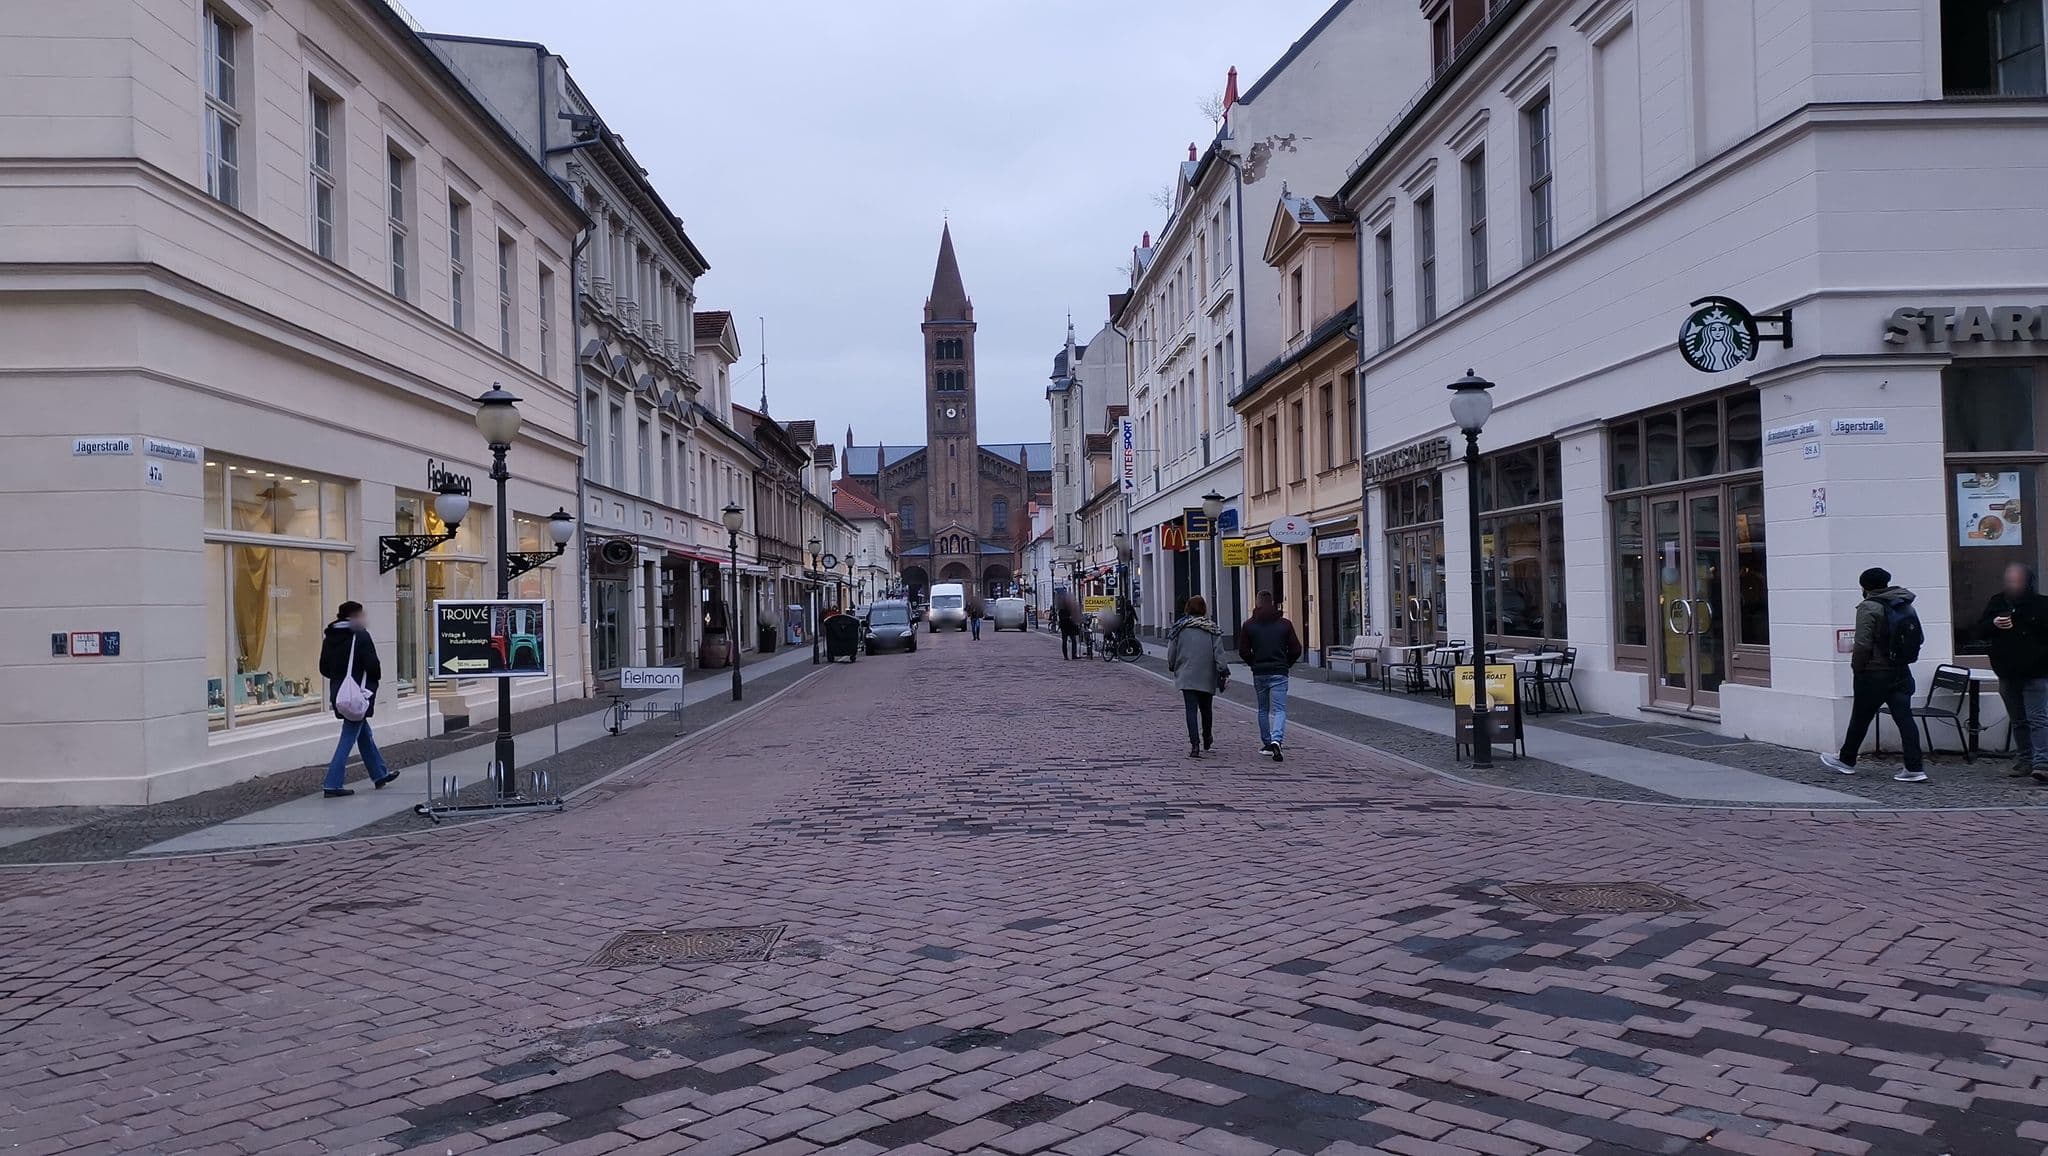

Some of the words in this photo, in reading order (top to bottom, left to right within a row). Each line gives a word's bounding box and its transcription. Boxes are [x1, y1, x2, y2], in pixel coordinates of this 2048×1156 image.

[1883, 305, 2048, 344] STAR
[1835, 420, 1884, 434] Jägerstraße
[76, 440, 130, 454] Jägerstraße
[1124, 420, 1133, 479] INTERSPORT
[441, 606, 488, 620] TROUVÉ
